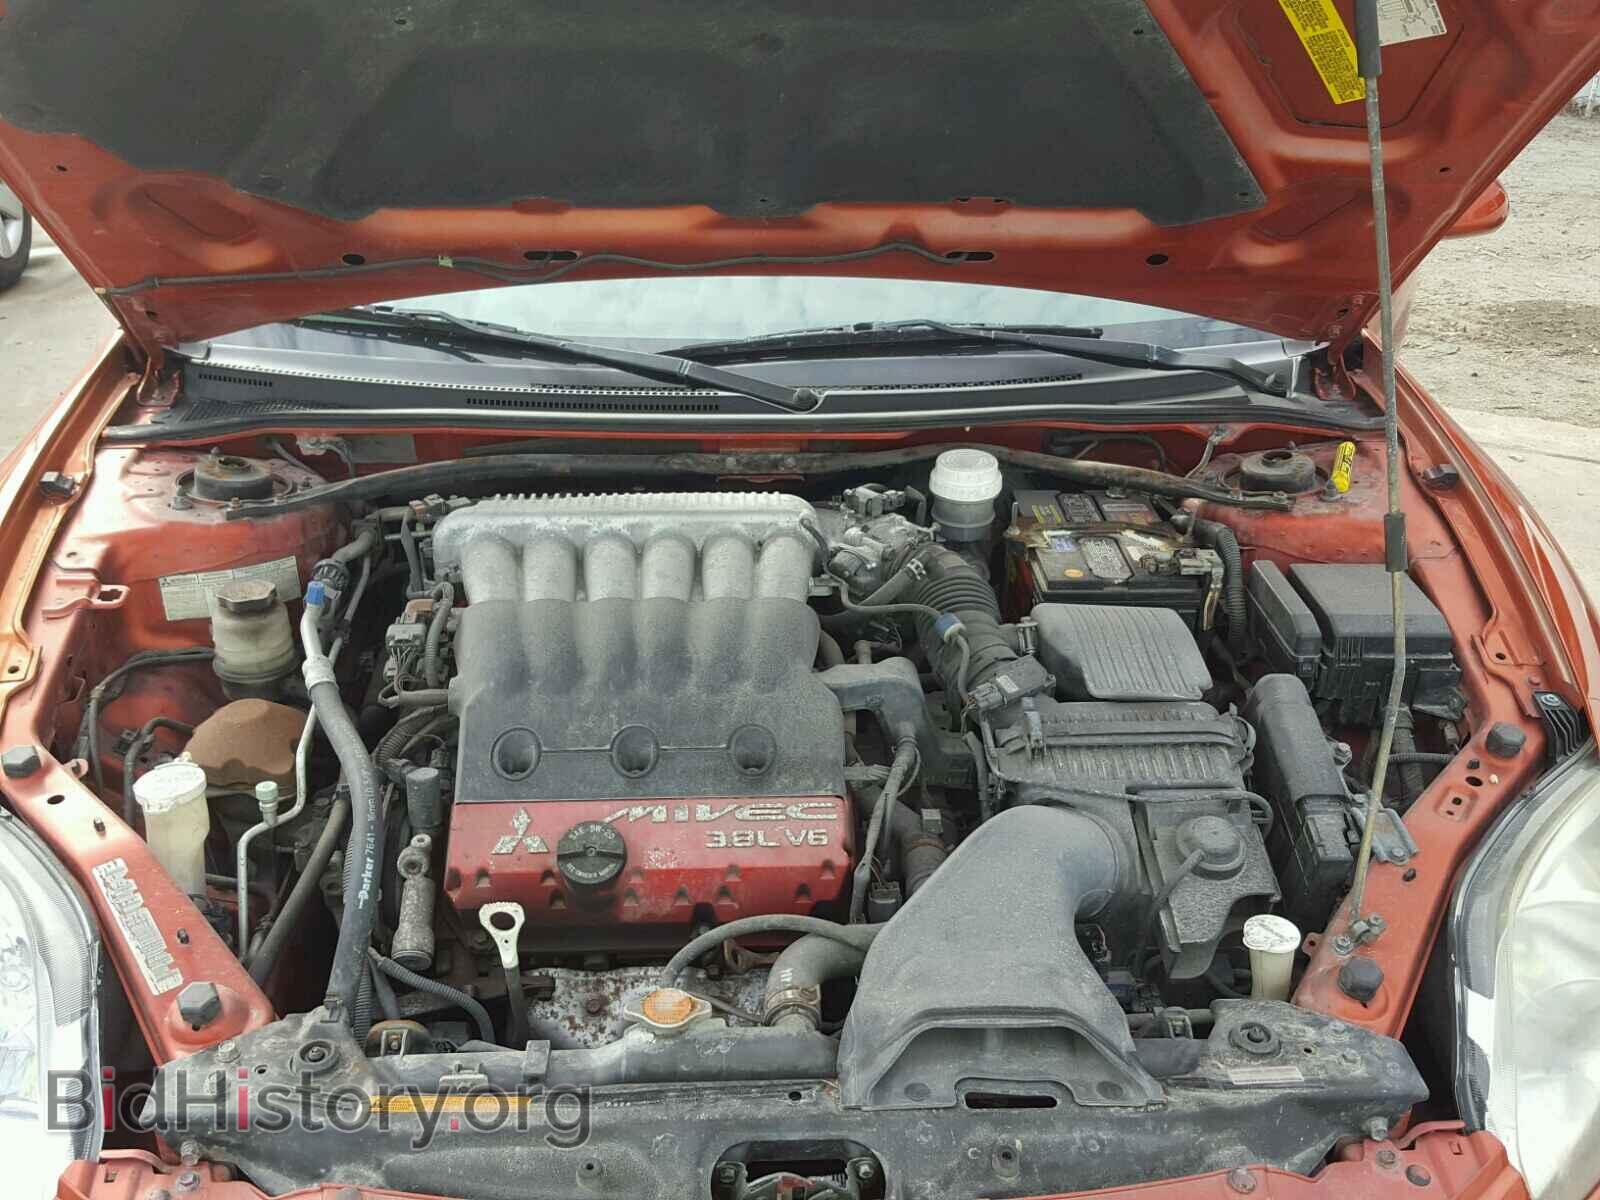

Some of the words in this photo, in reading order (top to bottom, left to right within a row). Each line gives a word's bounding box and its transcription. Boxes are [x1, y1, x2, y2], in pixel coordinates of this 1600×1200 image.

[705, 829, 781, 848] 3.8L
[783, 827, 829, 846] V6
[358, 857, 374, 909] Parker
